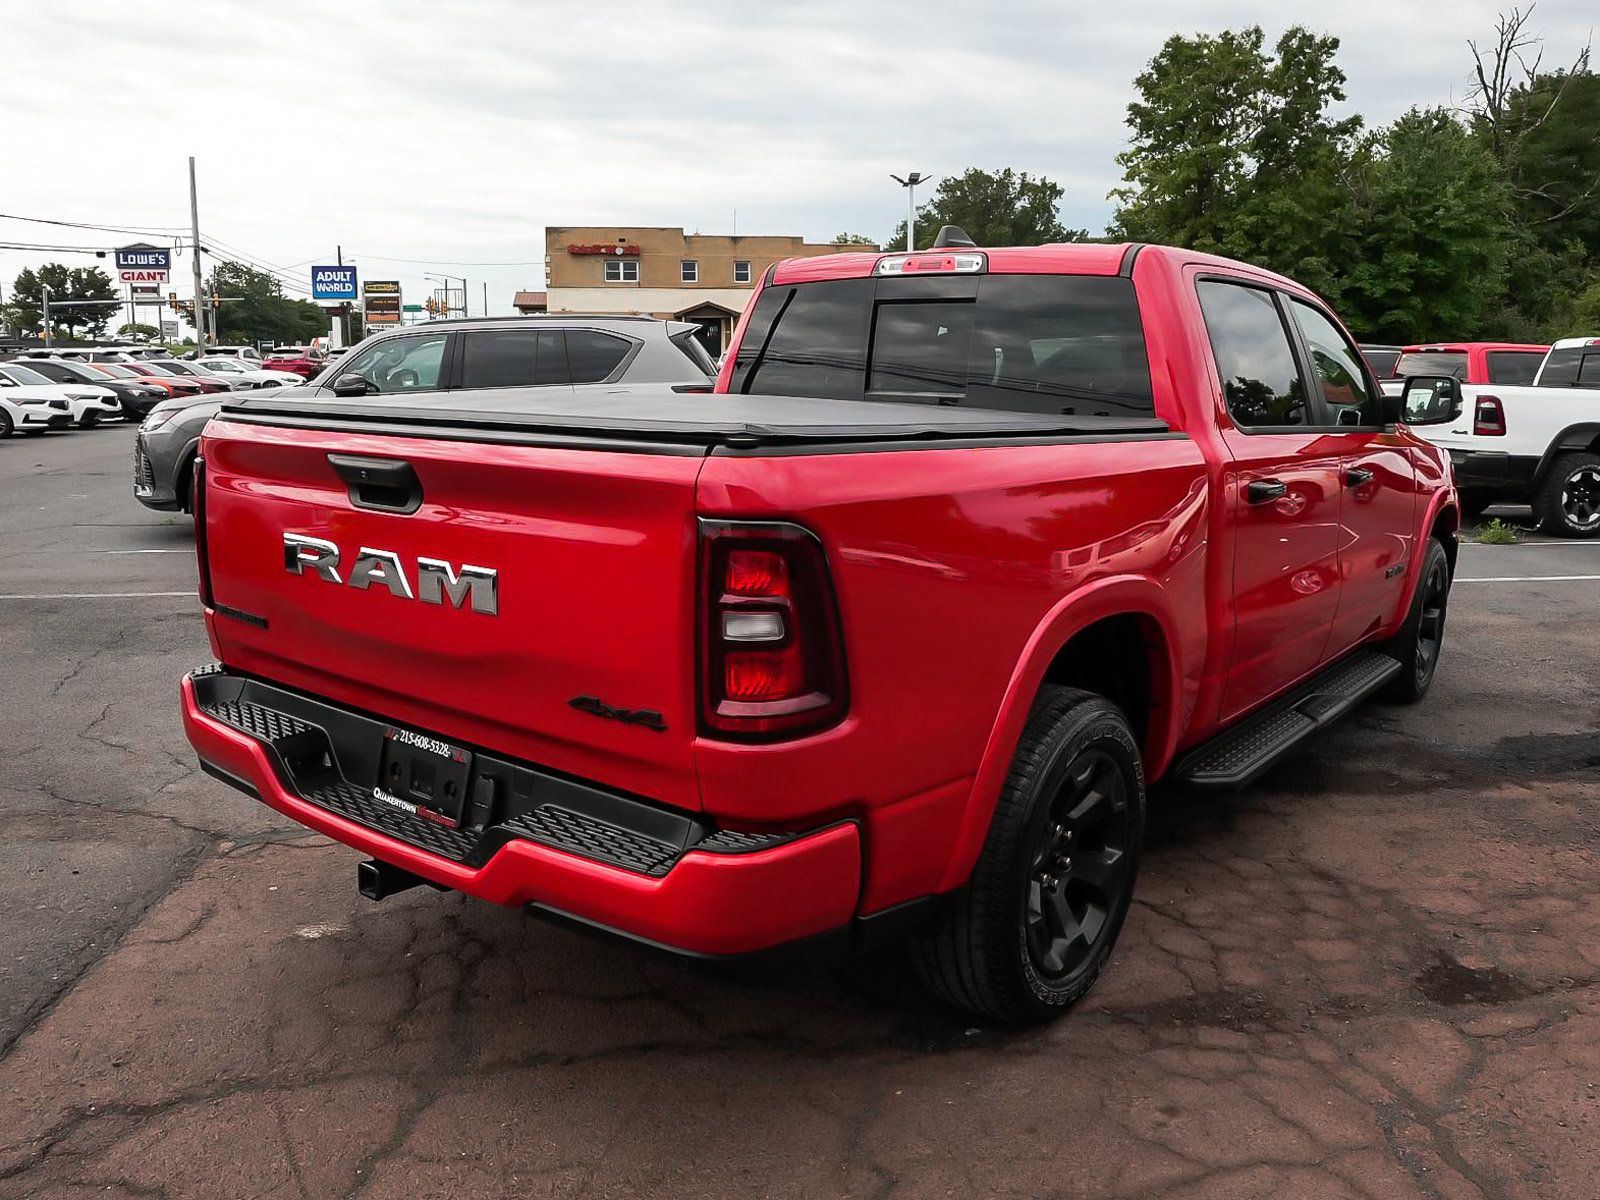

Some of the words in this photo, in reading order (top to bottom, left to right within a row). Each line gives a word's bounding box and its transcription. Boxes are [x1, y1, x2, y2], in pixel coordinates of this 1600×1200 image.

[119, 253, 166, 265] LOWE'S
[120, 271, 166, 281] GIANT
[316, 271, 352, 282] ADULT
[316, 282, 353, 293] WORLD
[283, 532, 499, 615] RAM
